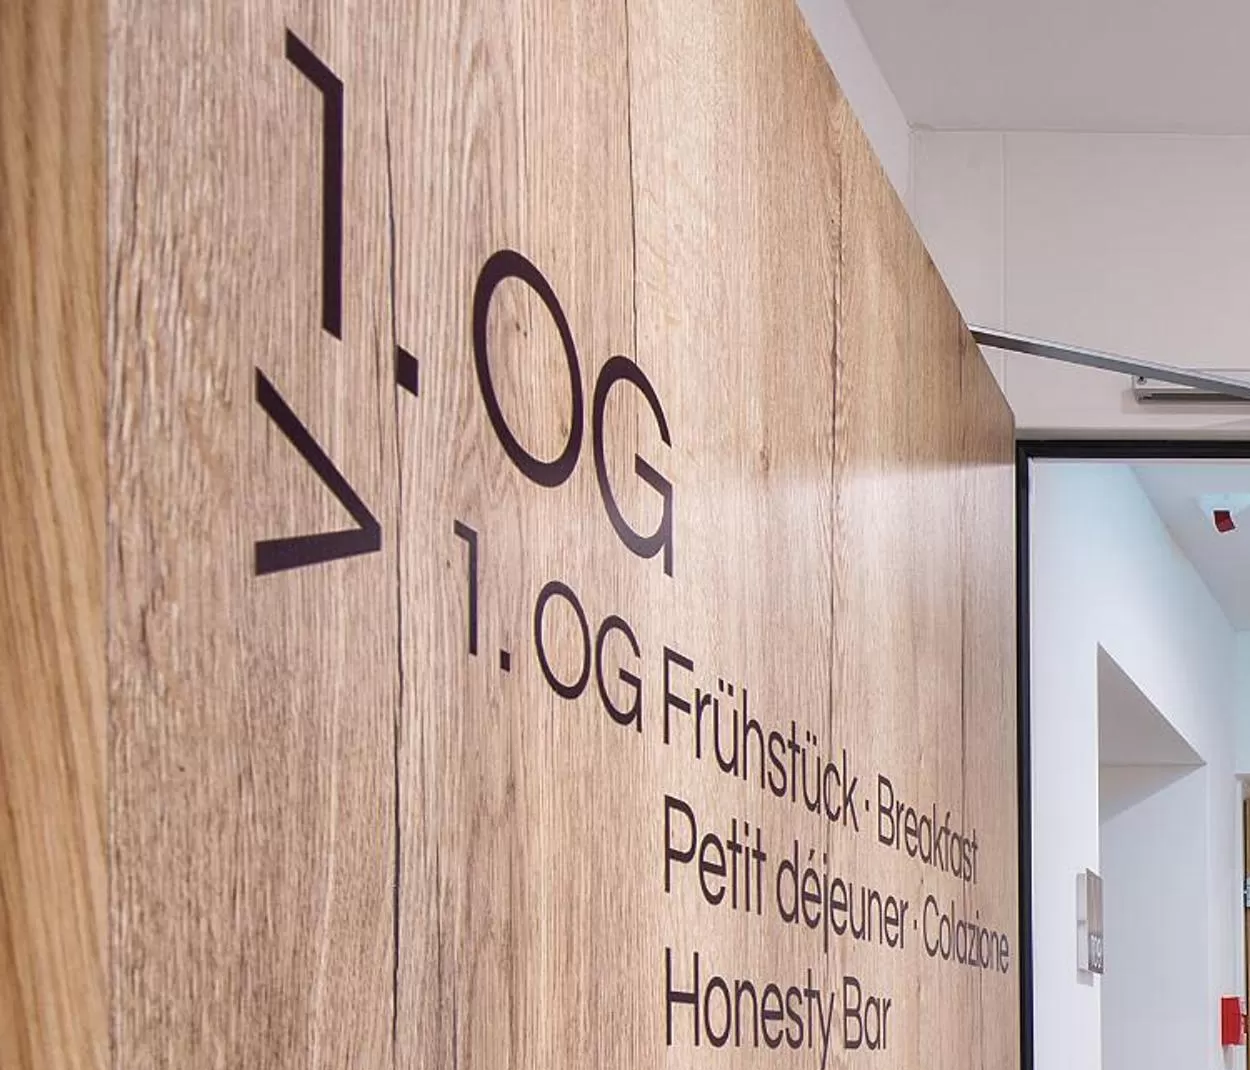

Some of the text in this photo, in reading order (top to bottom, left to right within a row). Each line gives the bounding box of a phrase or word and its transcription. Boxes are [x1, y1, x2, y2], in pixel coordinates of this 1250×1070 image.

[534, 581, 642, 733] OG
[663, 646, 859, 833] Frühstück
[877, 773, 978, 884] Breakfast
[664, 794, 1010, 974] Petit déjeuner Colazione
[665, 947, 891, 1070] Honesty Bar
